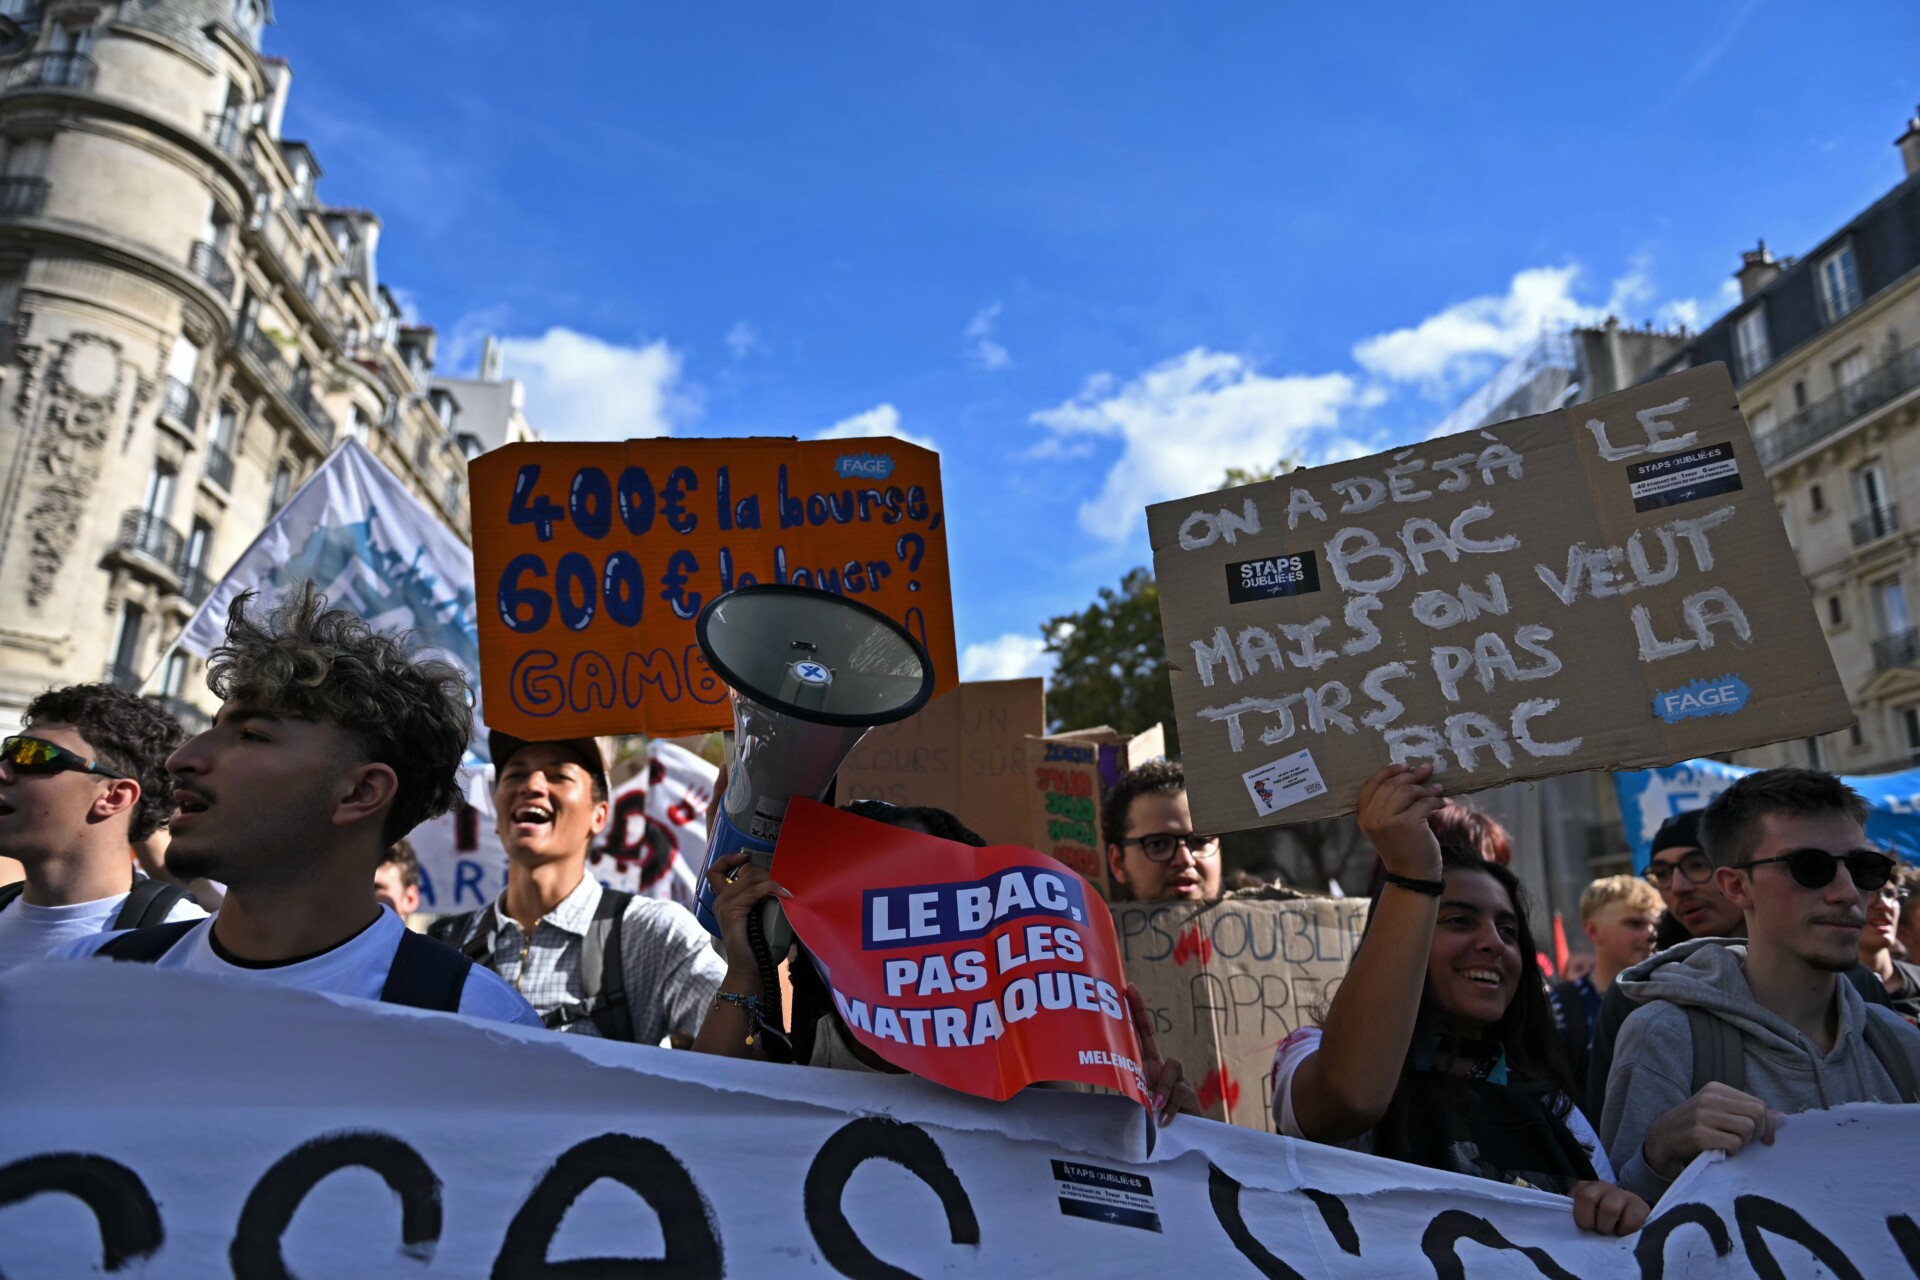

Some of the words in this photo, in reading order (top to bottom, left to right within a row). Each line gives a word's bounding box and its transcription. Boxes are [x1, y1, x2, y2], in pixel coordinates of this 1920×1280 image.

[716, 465, 762, 531] la
[778, 463, 942, 532] bourse,
[842, 459, 887, 472] FAGE
[1178, 497, 1264, 551] ON
[1285, 486, 1328, 531] A
[1585, 396, 1699, 462] LE
[1638, 460, 1671, 475] STAPS
[1240, 556, 1303, 579] STAPS
[1324, 500, 1522, 593] BAC
[1190, 592, 1384, 688] MAIS
[1409, 571, 1513, 629] ON
[1534, 504, 1737, 607] VEUT
[1430, 623, 1563, 702] PAS
[1630, 586, 1753, 662] LA
[1664, 684, 1739, 713] FAGE
[872, 892, 941, 942] LE
[956, 871, 1082, 932] BAC,
[884, 950, 988, 997] PAS
[995, 926, 1084, 975] LES
[833, 971, 1123, 1047] MATRAQUES
